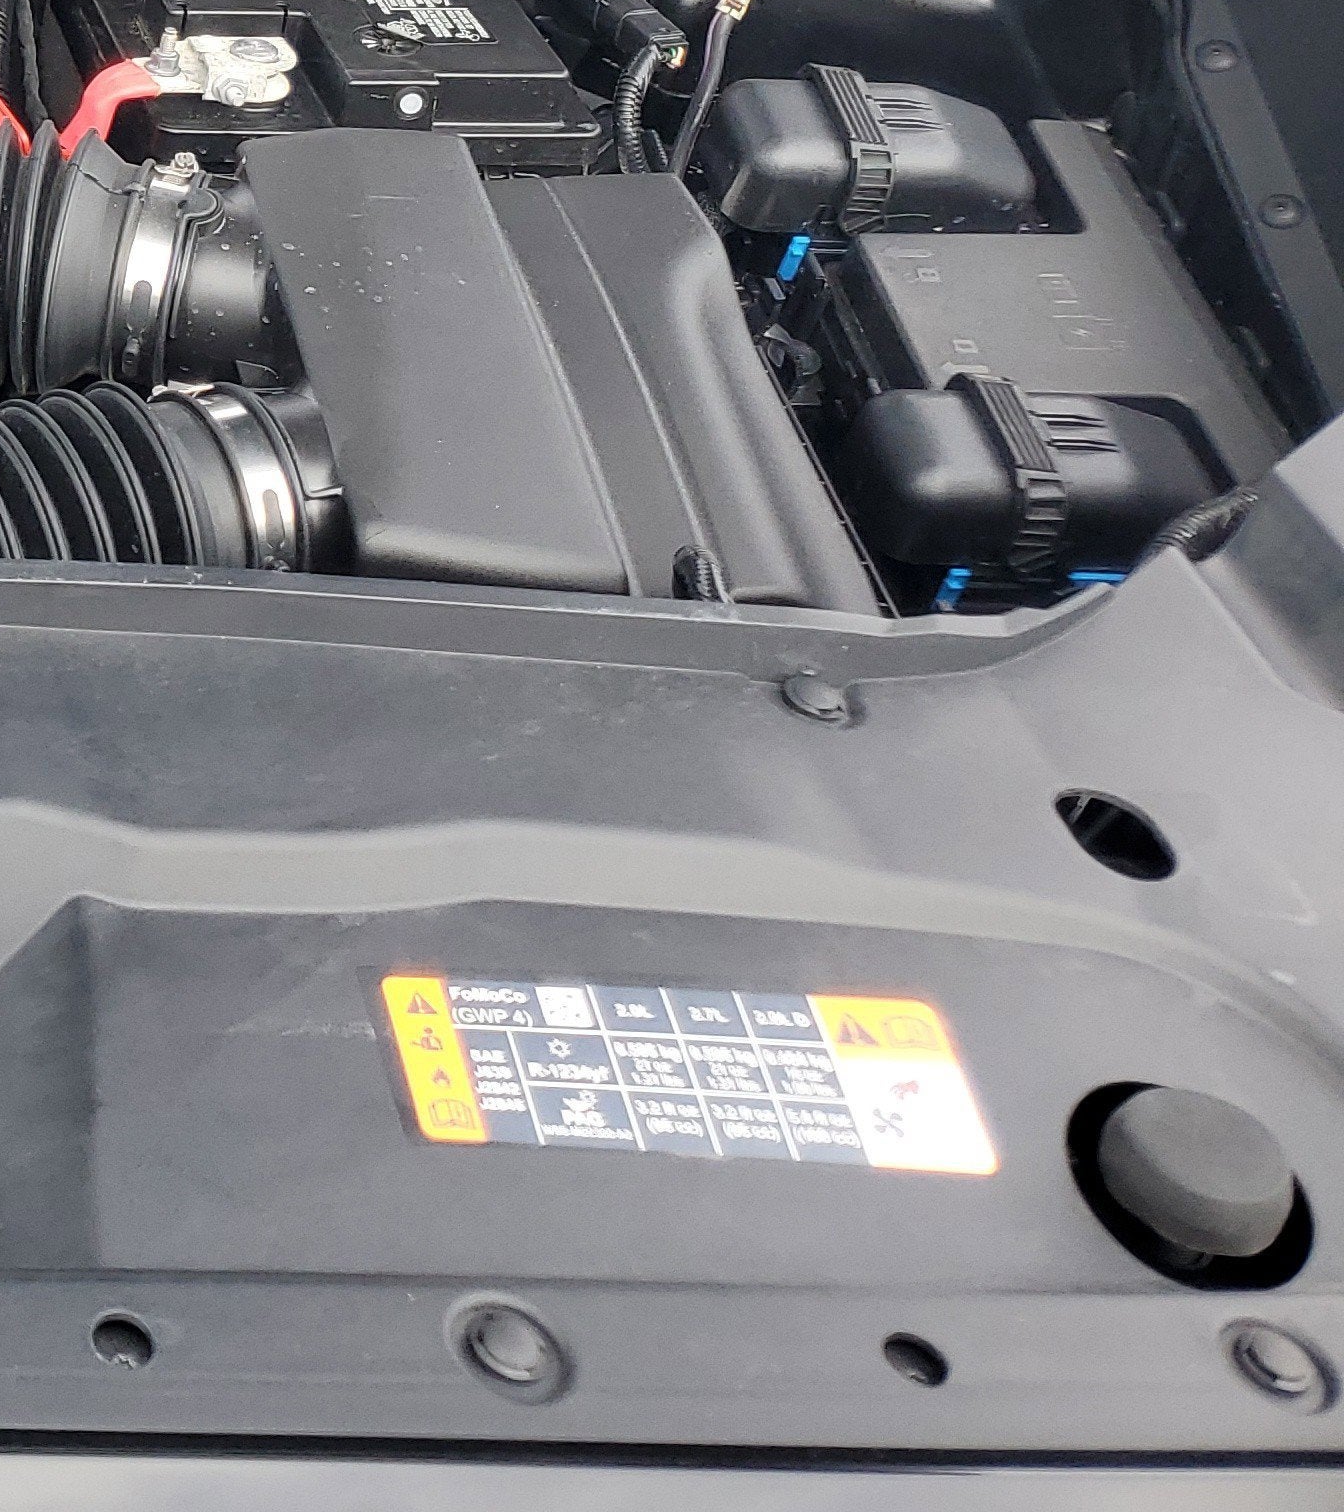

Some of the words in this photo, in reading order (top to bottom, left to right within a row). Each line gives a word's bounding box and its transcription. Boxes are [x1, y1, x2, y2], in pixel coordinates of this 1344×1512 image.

[448, 986, 530, 1003] FoMoCo
[451, 1006, 509, 1025] (GWP
[513, 1008, 533, 1028] 4)
